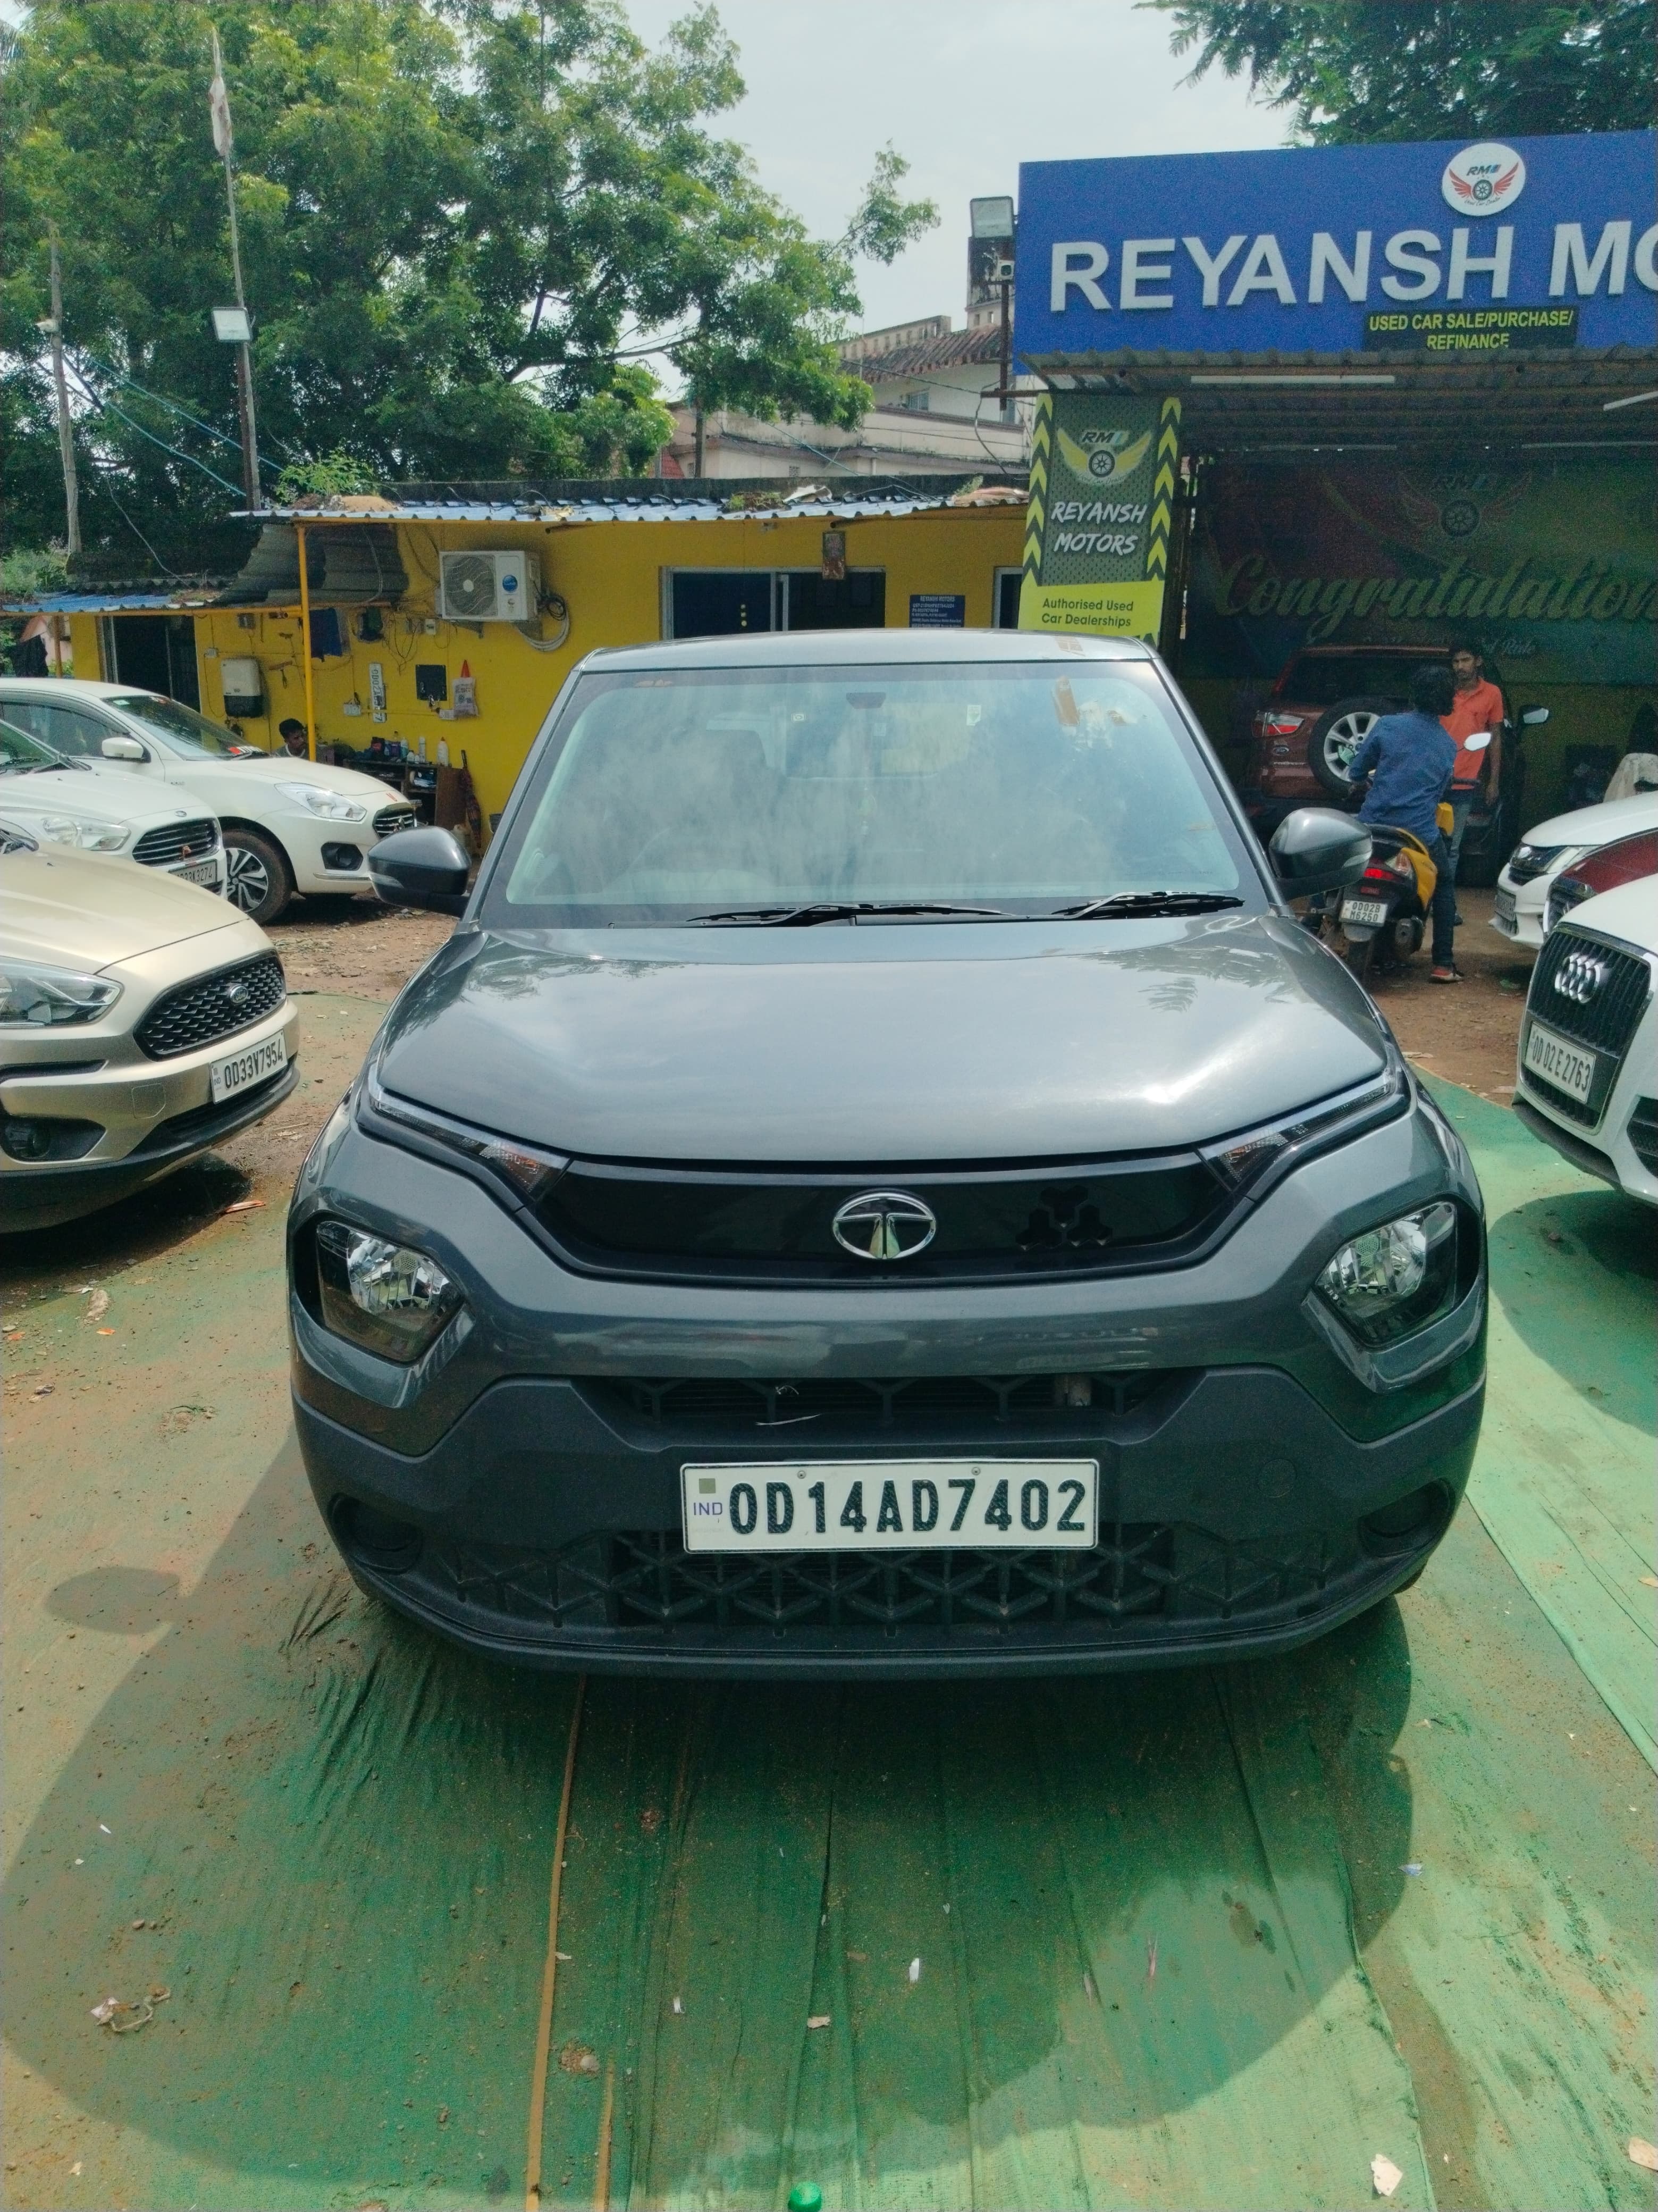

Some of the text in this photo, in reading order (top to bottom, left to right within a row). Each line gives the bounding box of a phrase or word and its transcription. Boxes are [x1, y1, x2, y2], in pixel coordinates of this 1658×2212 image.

[1050, 225, 1514, 312] REYANSH
[1369, 310, 1574, 331] USED CAR SALE/PURCHASE/
[1427, 333, 1510, 350] REFINANCE
[1050, 501, 1148, 525] REYANSH
[1054, 532, 1139, 556] MOTORS
[1042, 598, 1133, 611] Authorised Used
[1041, 613, 1131, 629] Car Dealerships
[693, 1502, 723, 1515] IND
[729, 1478, 1086, 1535] OD14AD7402
